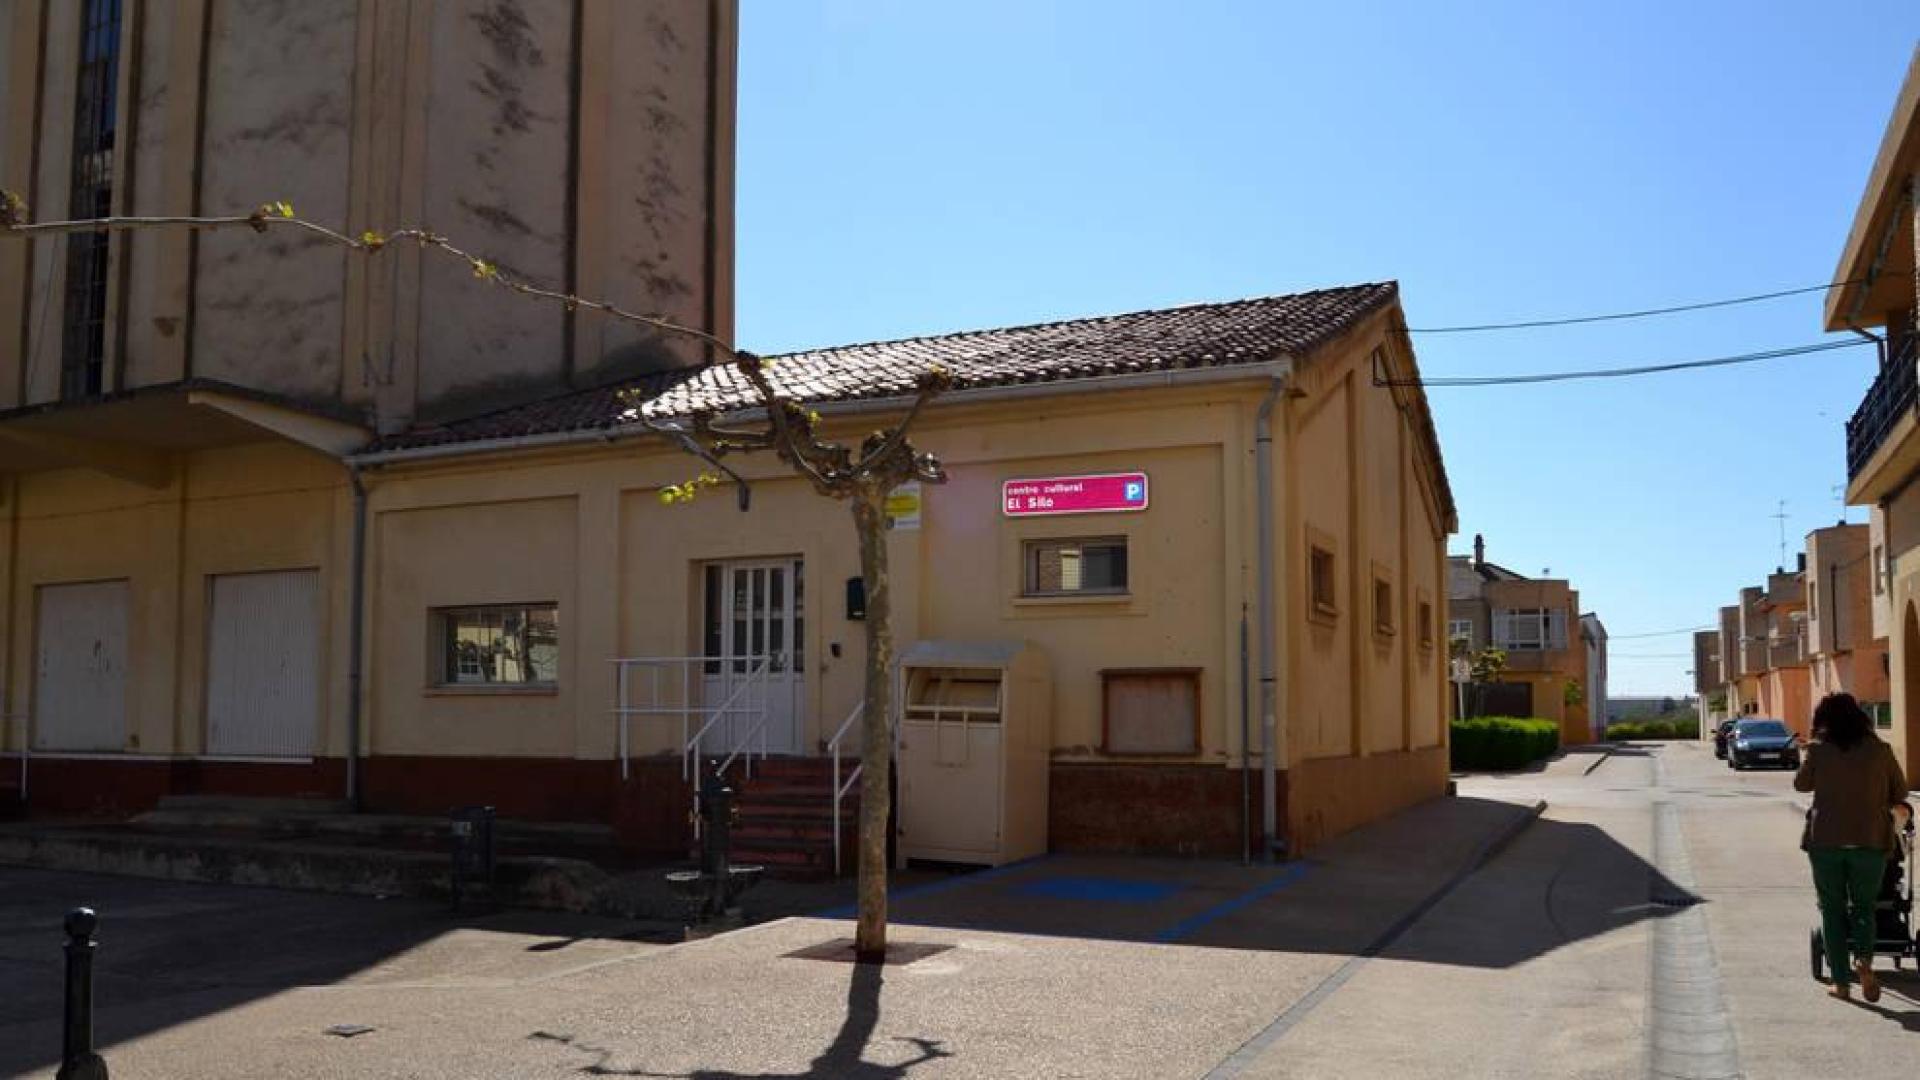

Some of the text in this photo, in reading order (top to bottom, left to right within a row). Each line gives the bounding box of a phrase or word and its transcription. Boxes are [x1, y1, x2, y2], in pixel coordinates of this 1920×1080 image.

[1008, 482, 1082, 495] centro cultural
[1127, 483, 1140, 499] P
[1008, 496, 1054, 509] El Silo
